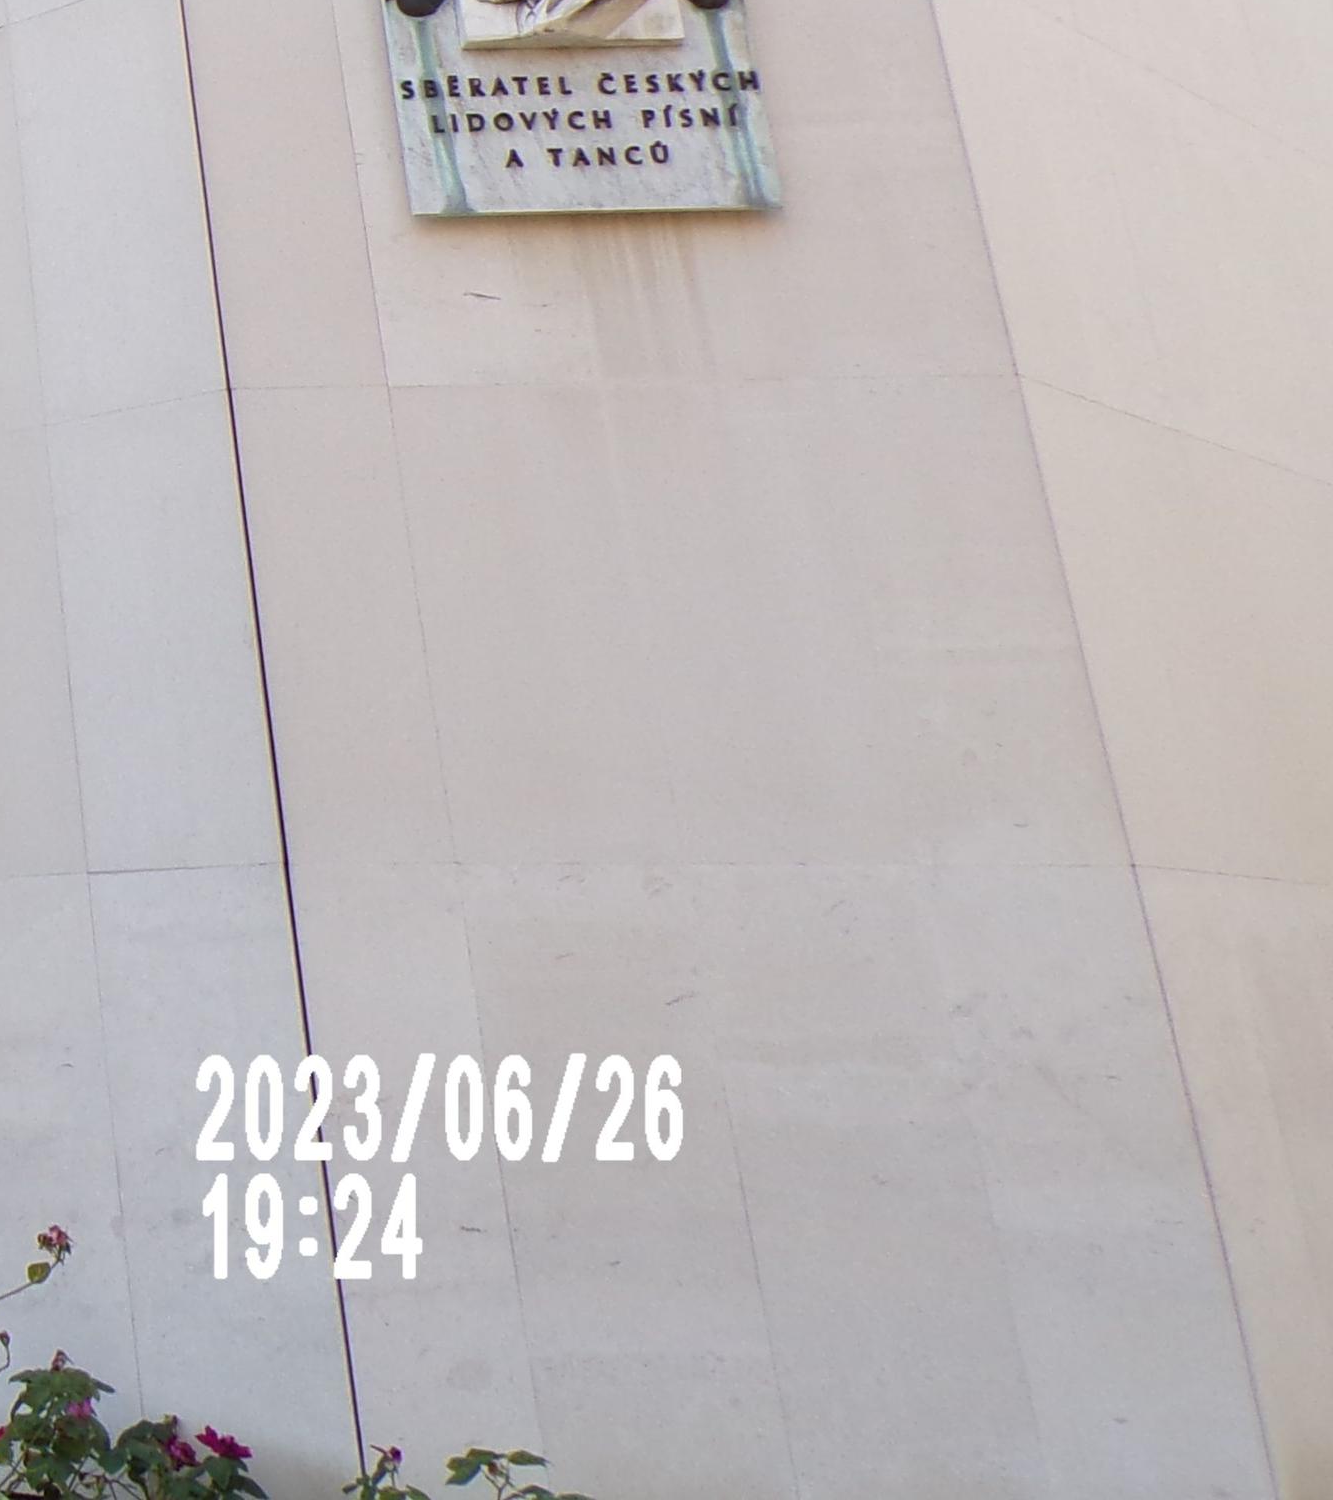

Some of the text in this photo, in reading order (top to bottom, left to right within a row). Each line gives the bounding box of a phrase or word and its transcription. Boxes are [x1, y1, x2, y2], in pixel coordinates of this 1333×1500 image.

[400, 68, 763, 100] SBĚRATEL ČESKÝCH
[431, 103, 740, 134] LIDOVÝCH PÍSNÍ
[505, 140, 671, 169] A TANCŮ
